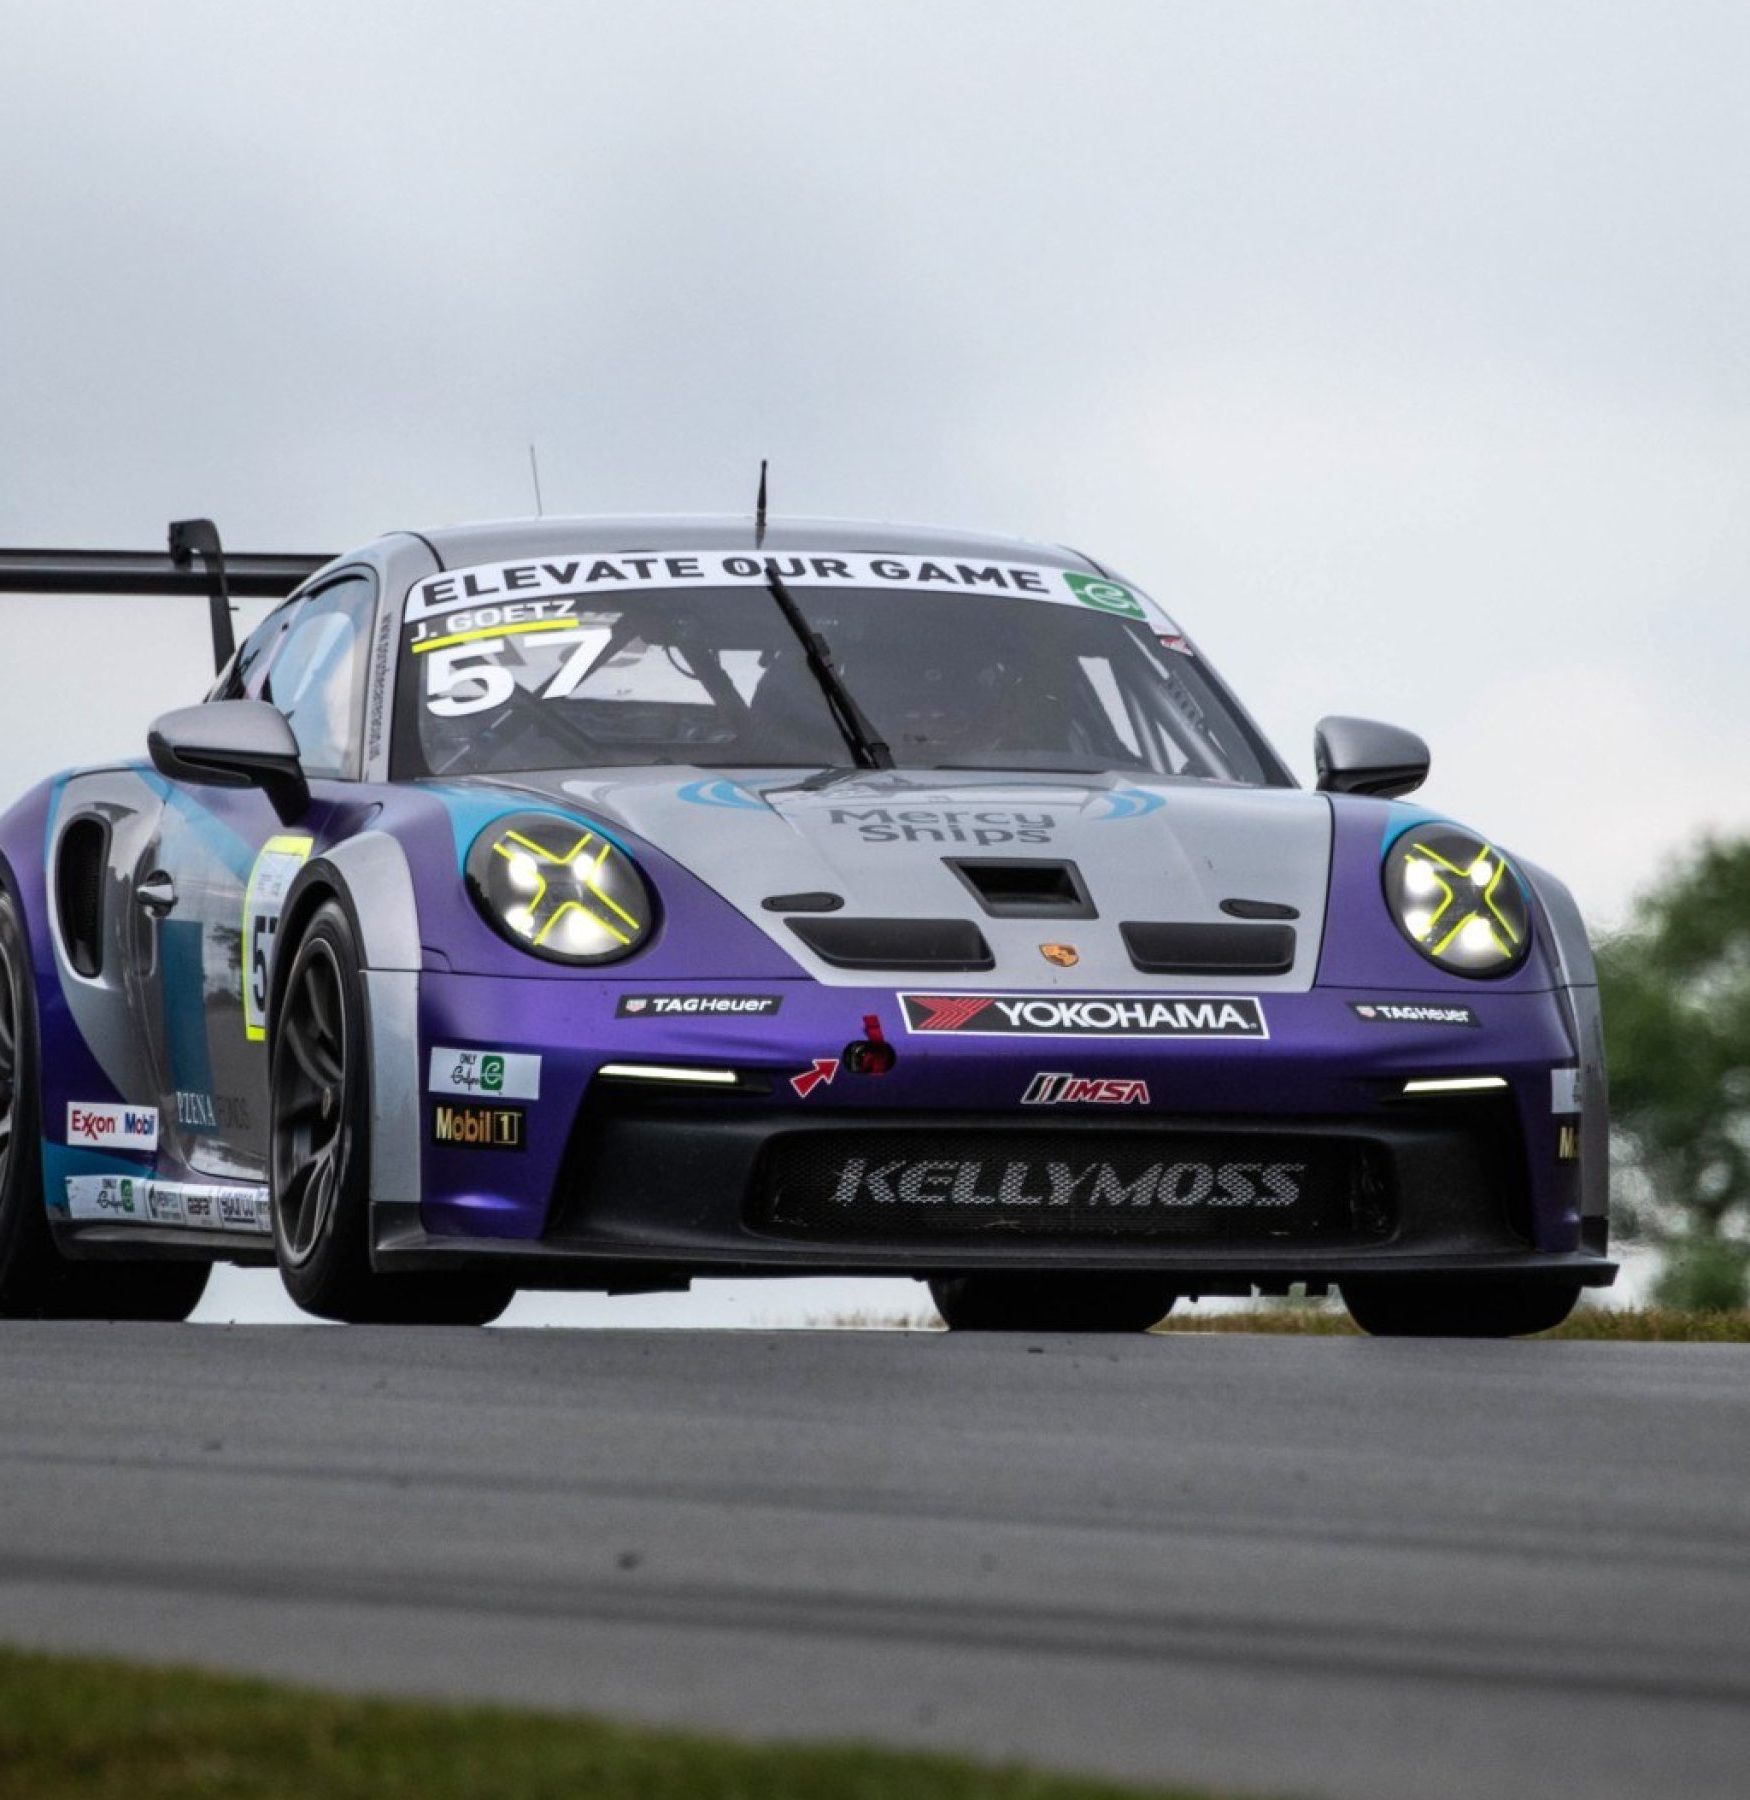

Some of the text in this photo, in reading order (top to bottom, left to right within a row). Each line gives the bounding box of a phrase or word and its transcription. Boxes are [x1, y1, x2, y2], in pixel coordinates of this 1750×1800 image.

[422, 554, 1051, 607] ELEVATE OUR GAME
[411, 600, 576, 643] J. GOETZ
[426, 628, 613, 717] 57
[829, 808, 1056, 828] Mercy
[857, 824, 1052, 847] Ships
[994, 1002, 1247, 1030] YOKOHAMA
[1062, 1078, 1150, 1103] IMSA
[71, 1110, 155, 1139] Exxon Mobil
[435, 1106, 491, 1142] Mobil
